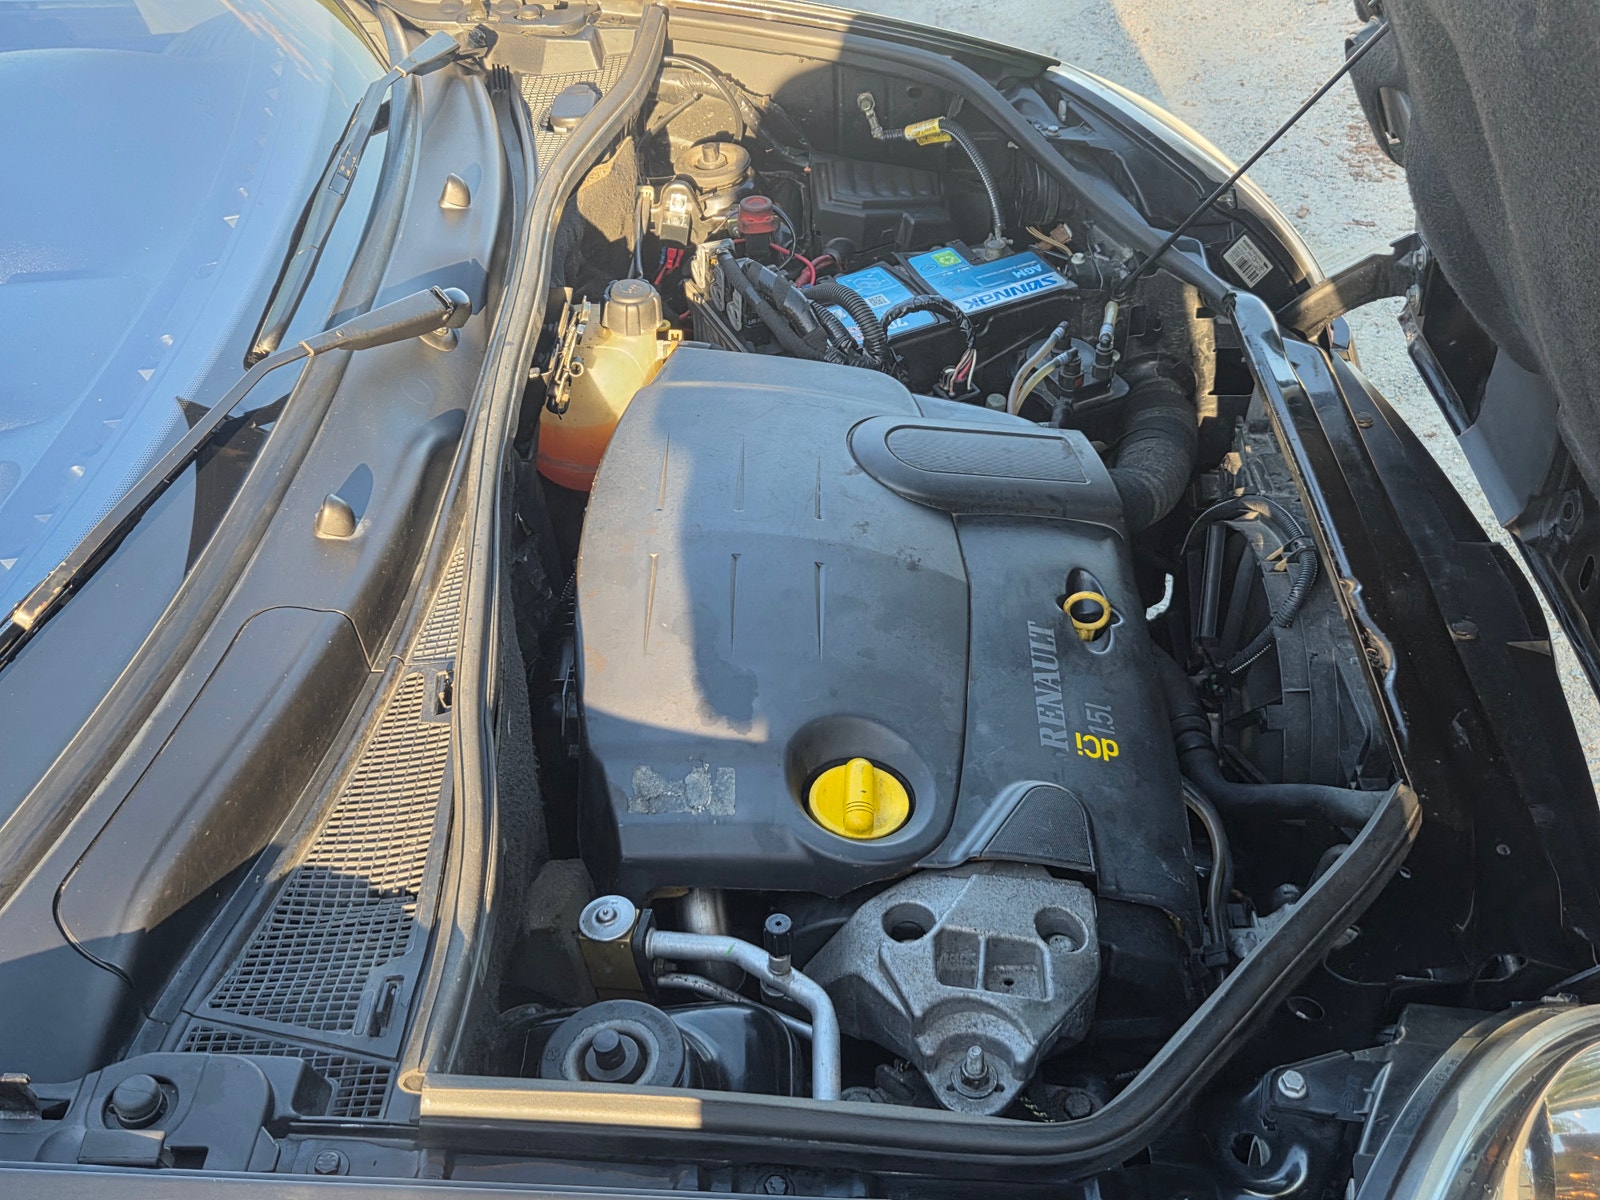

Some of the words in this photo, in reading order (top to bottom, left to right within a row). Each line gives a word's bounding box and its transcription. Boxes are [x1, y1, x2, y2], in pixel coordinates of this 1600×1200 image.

[1012, 263, 1042, 279] AGM
[1027, 620, 1069, 751] RENAULT
[1075, 732, 1119, 762] dCi
